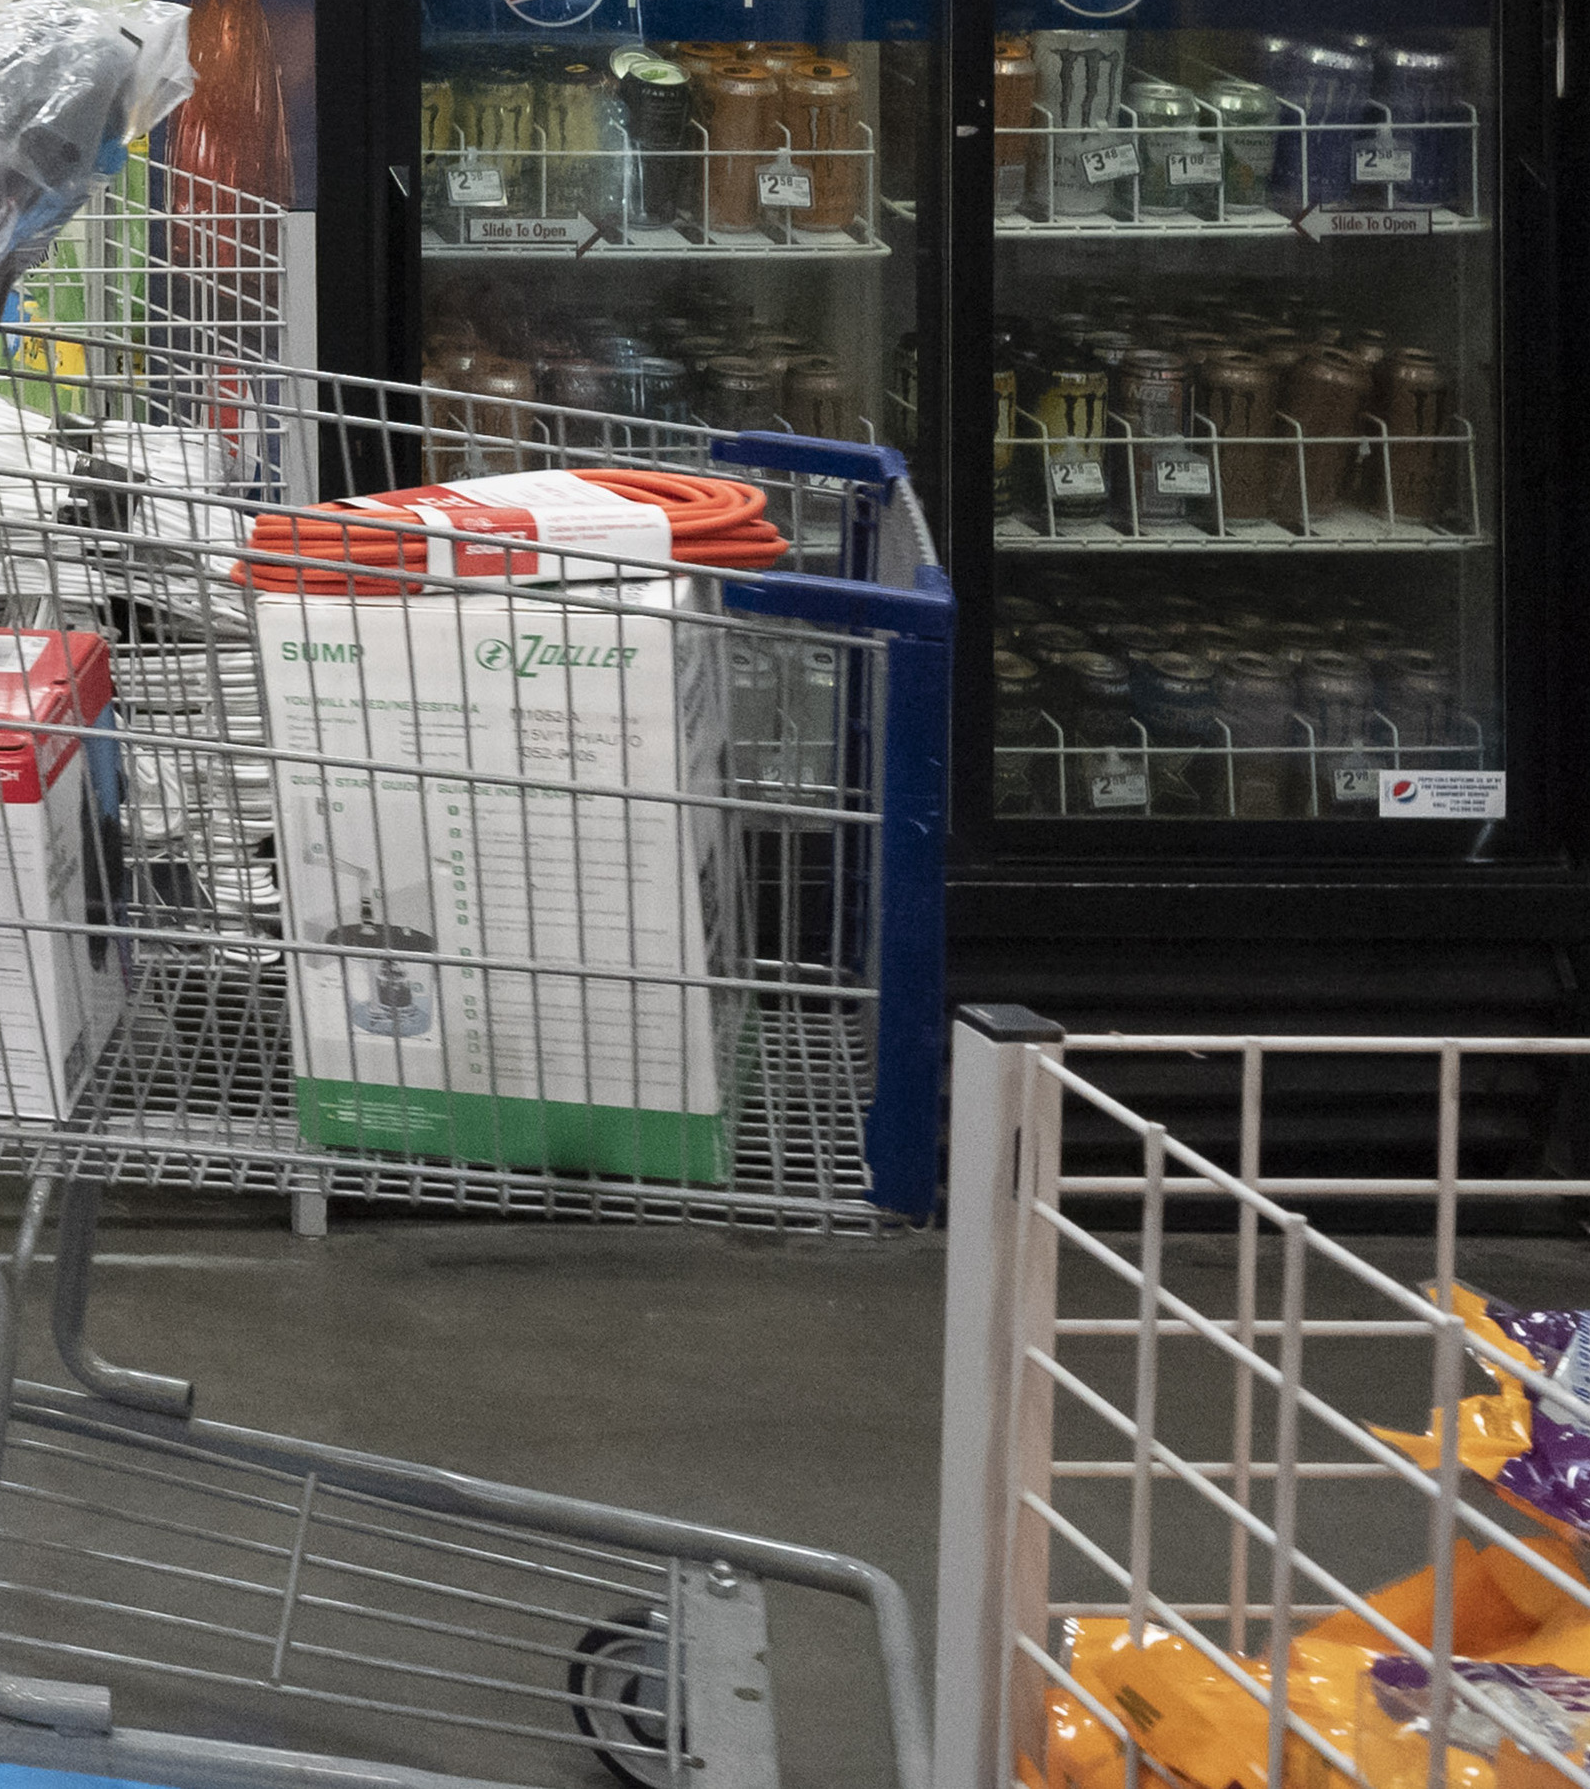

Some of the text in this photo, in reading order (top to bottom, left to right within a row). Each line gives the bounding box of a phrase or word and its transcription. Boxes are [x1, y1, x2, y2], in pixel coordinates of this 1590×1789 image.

[482, 222, 567, 242] Slide To Open
[1331, 215, 1418, 235] Slide To Open
[516, 633, 639, 678] ZOELLER
